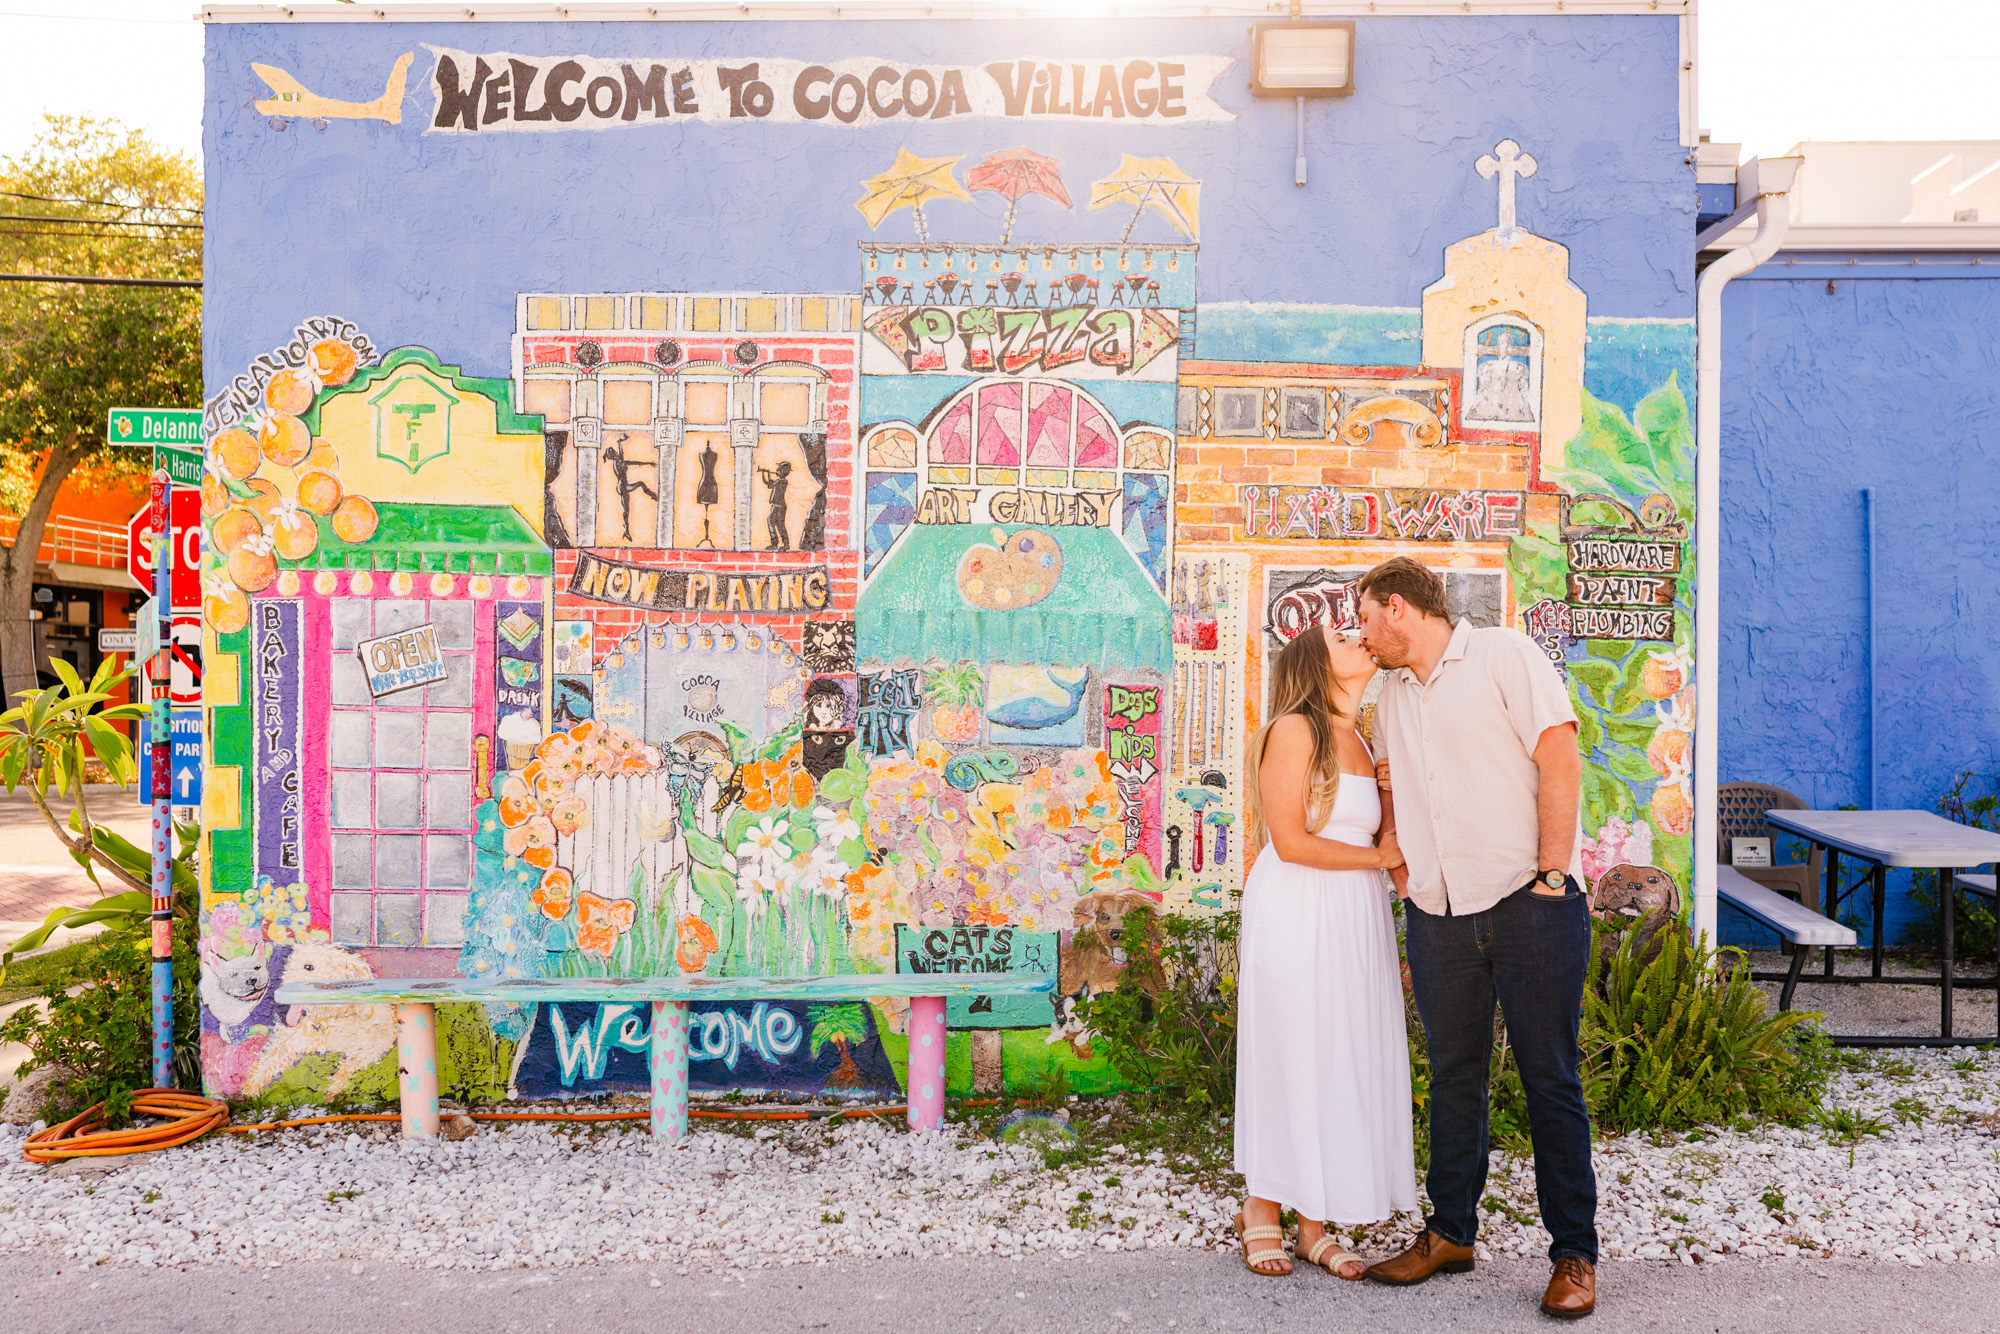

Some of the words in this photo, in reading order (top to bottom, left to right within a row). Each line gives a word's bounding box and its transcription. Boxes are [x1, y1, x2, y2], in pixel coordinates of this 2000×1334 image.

[433, 55, 699, 131] WELCOME
[717, 62, 774, 117] TO
[793, 65, 972, 123] COCOA
[172, 454, 202, 481] Harris
[915, 489, 981, 525] ART
[988, 489, 1122, 528] GALLERY
[1245, 485, 1522, 541] HARDWARE
[1572, 541, 1675, 572] HARDWARE
[581, 558, 660, 605] NOW
[685, 572, 827, 612] PLAYING
[1574, 575, 1665, 604] PAINT
[1572, 609, 1673, 638] PLUMBING
[370, 629, 438, 673] OPEN
[261, 605, 287, 752] BAKERY
[682, 675, 720, 691] COCOA
[498, 689, 540, 708] DRINK
[683, 704, 724, 723] VILLAGE
[262, 749, 292, 784] AND
[280, 771, 299, 868] CAFE
[922, 928, 1014, 959] CATS
